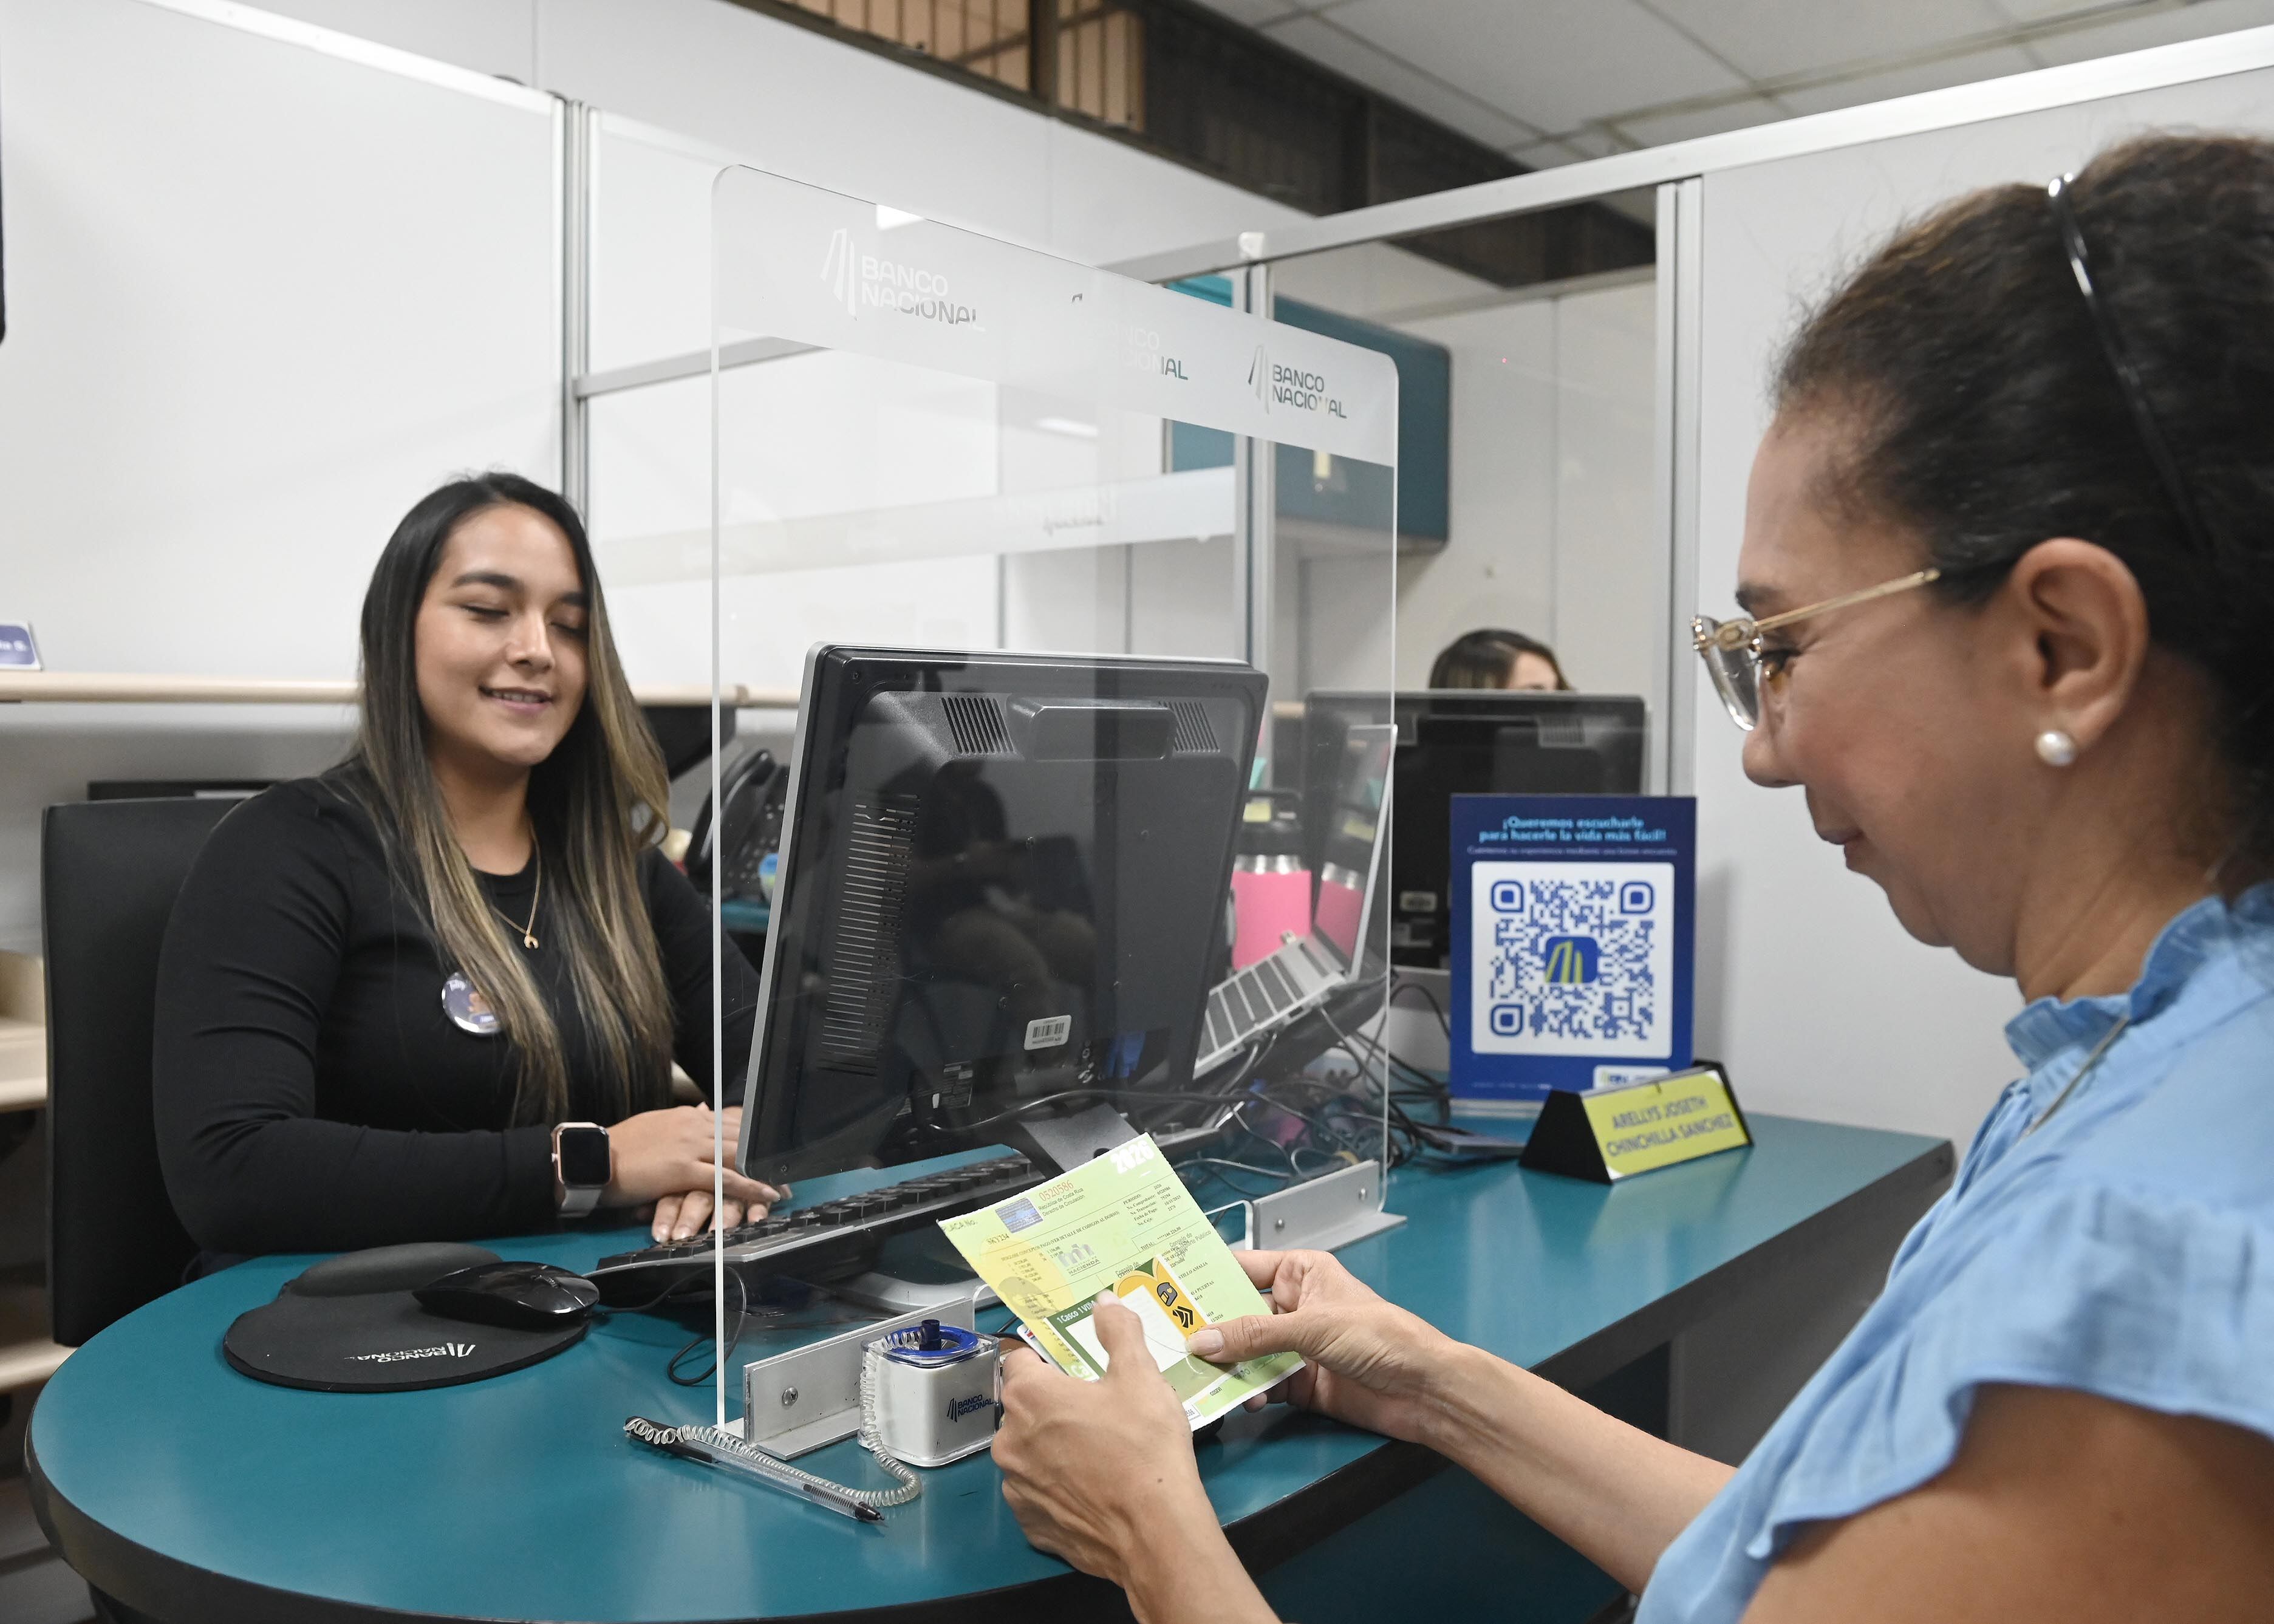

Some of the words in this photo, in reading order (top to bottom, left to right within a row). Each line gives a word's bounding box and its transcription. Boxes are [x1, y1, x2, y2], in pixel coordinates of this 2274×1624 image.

[861, 256, 948, 297] BANCO
[861, 281, 986, 332] NACIONAL
[1273, 364, 1325, 393] BANCO
[1273, 384, 1347, 419] NACIOAL
[1479, 831, 1509, 844] para
[1510, 828, 1558, 842] hacerle
[1559, 828, 1572, 842] la
[1574, 829, 1603, 842] vida
[1665, 1096, 1709, 1118] JOSETH
[1606, 1127, 1679, 1157] CHINCHILLA
[1678, 1113, 1734, 1139] SANCHEZ
[1110, 1139, 1155, 1175] 2026
[1039, 1179, 1074, 1201] 0520586
[1062, 1192, 1074, 1200] Costa
[1042, 1206, 1060, 1216] Derecho
[1068, 1258, 1100, 1275] HACIENDA
[1192, 1261, 1209, 1272] AMALIA
[1209, 1386, 1223, 1396] COSEVI
[957, 1394, 983, 1410] BANCO
[957, 1397, 994, 1417] NACIONAL
